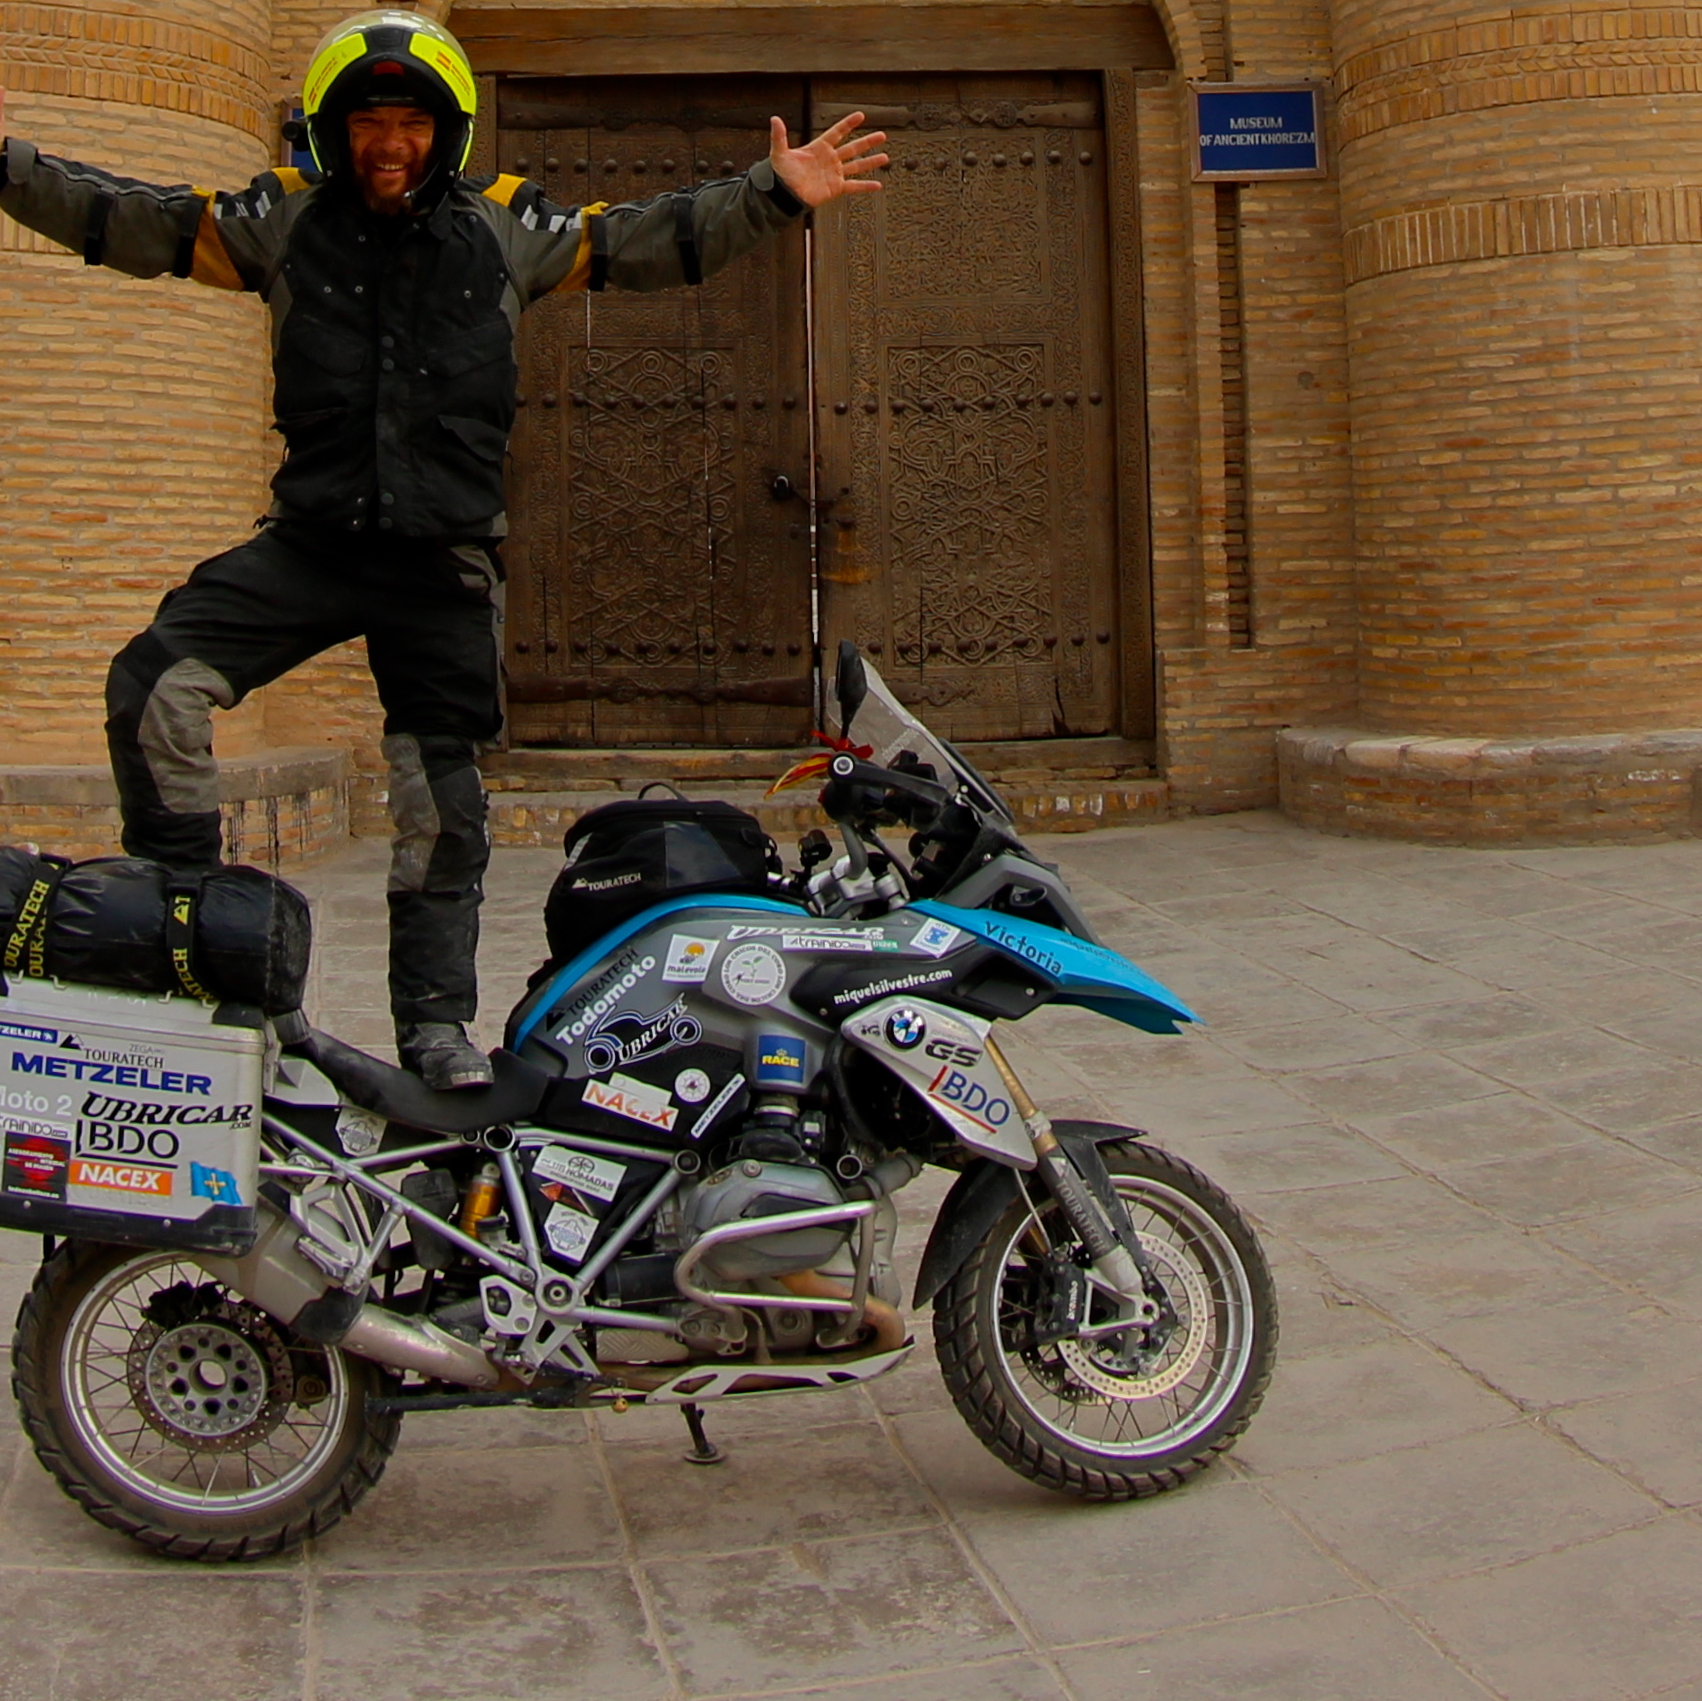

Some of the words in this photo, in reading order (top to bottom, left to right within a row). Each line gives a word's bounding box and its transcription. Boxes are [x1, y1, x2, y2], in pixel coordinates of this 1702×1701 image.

[1199, 134, 1213, 146] OF
[1213, 133, 1260, 146] ANCIENT
[1260, 132, 1316, 144] KHOREZM
[1229, 116, 1283, 129] MUSEUM
[588, 873, 642, 891] TOURATECH
[4, 879, 51, 969] OURATECH
[984, 921, 1063, 975] Victoria
[567, 948, 640, 1016] TOURATECH
[833, 969, 953, 1004] miquelsilvestre.com
[556, 955, 656, 1045] Todomoto
[84, 1048, 164, 1069] TOURATECH
[761, 1055, 800, 1068] RACE
[925, 1038, 983, 1067] GS
[11, 1051, 213, 1096] METZELER
[55, 1094, 73, 1116] 2
[81, 1091, 254, 1126] UBRICAR
[694, 1085, 733, 1134] METZELER
[942, 1070, 1011, 1126] BDO
[89, 1121, 179, 1159] BDO
[79, 1163, 161, 1191] NACEX
[566, 1167, 615, 1192] NOMADAS
[1056, 1180, 1110, 1253] TOURATECH
[1067, 1280, 1078, 1320] brembo
